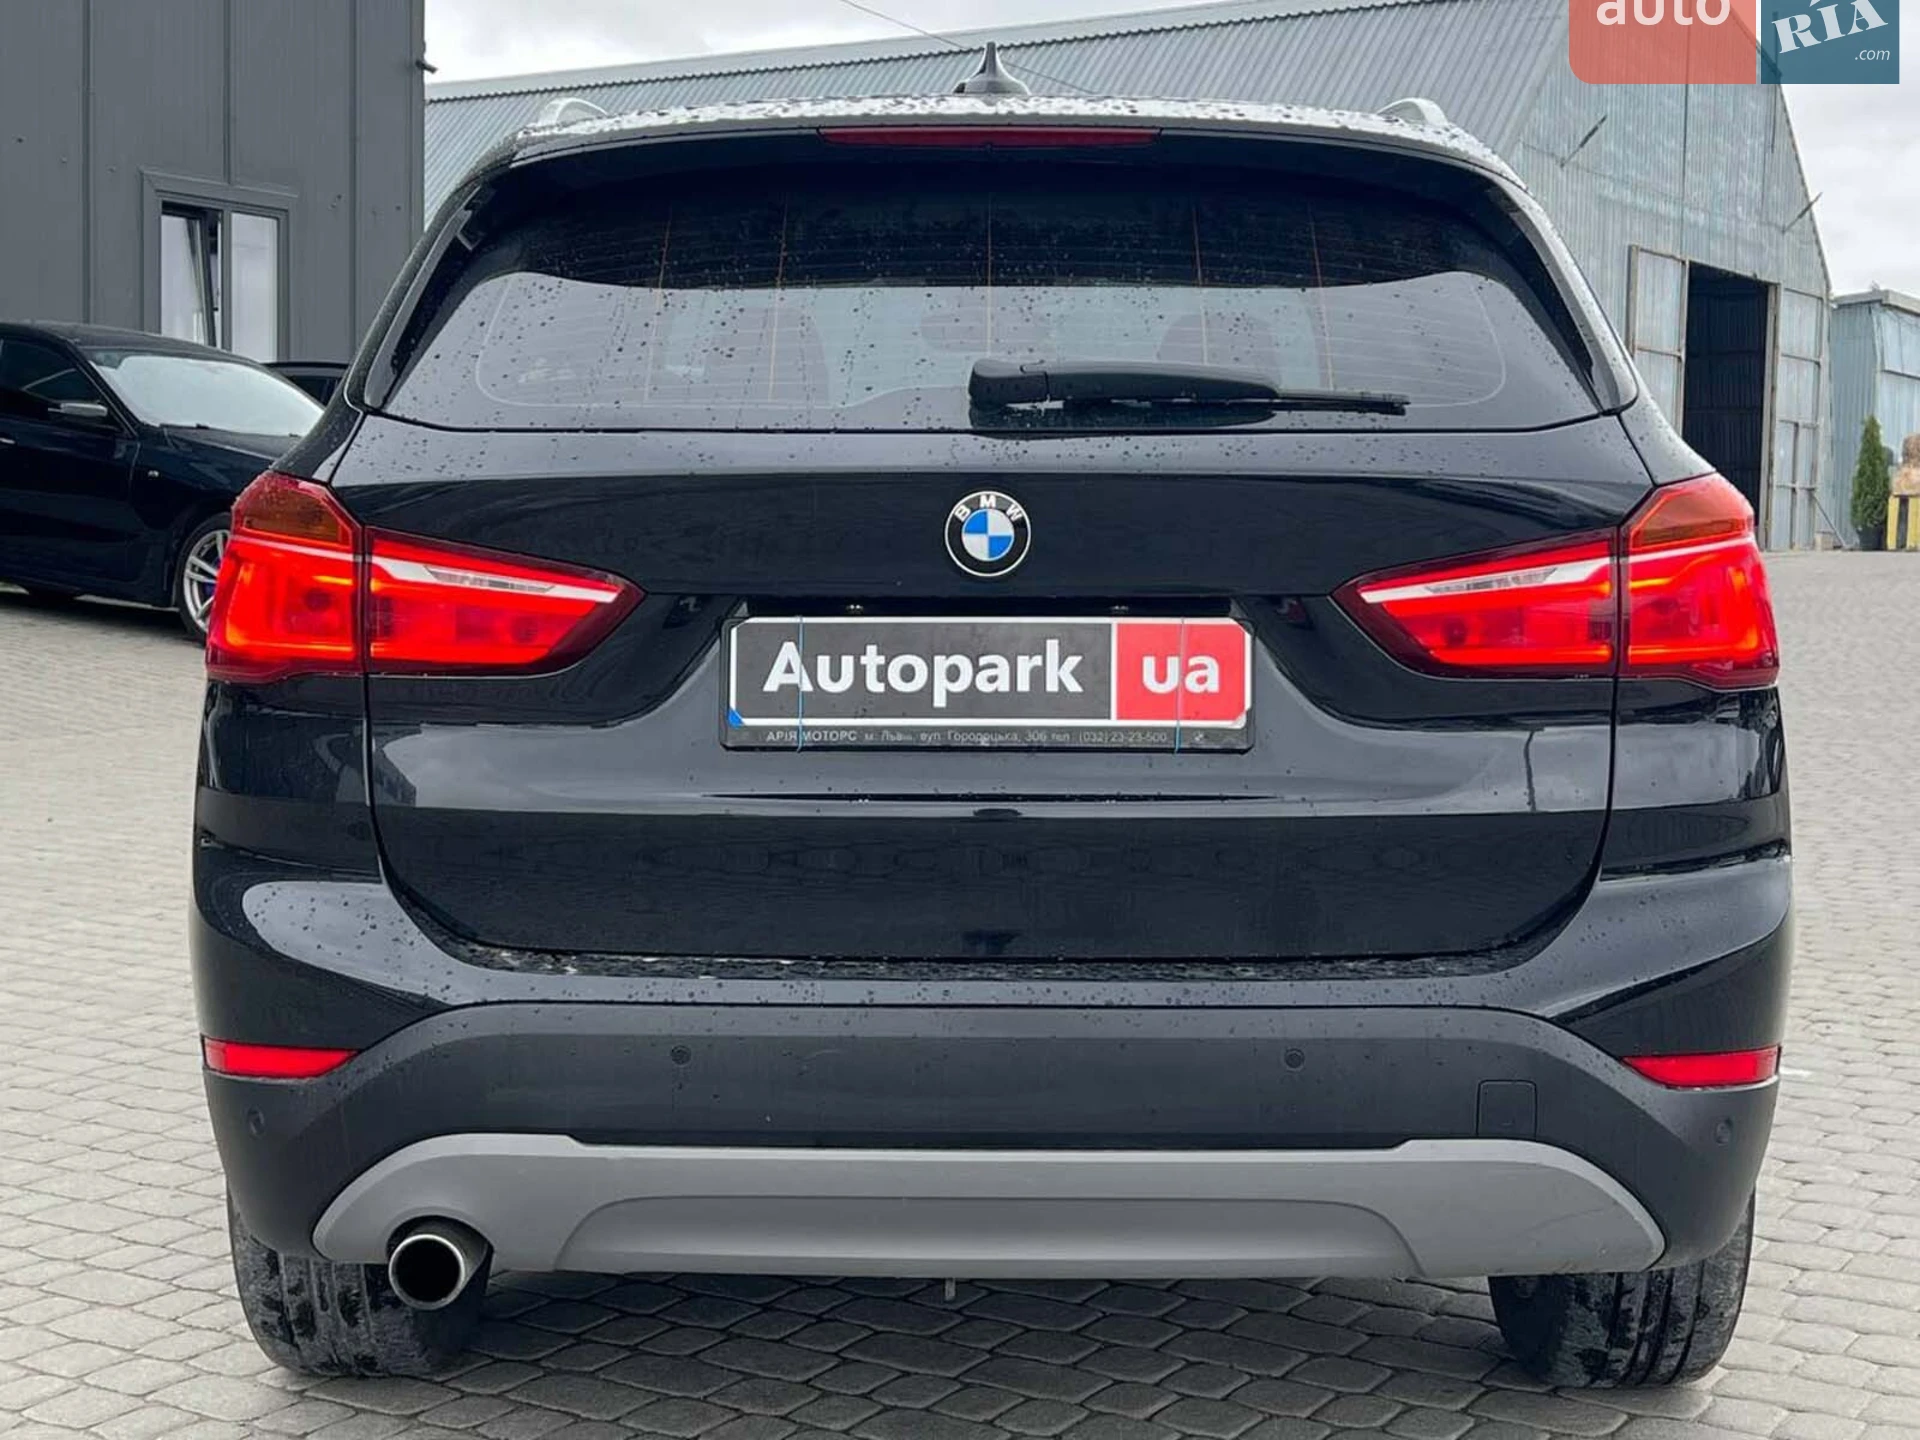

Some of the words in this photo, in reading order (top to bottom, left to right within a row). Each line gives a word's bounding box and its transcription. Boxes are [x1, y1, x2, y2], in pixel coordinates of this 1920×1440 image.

[954, 494, 1023, 522] BMW
[762, 639, 1085, 708] Autopark
[1141, 654, 1221, 694] ua
